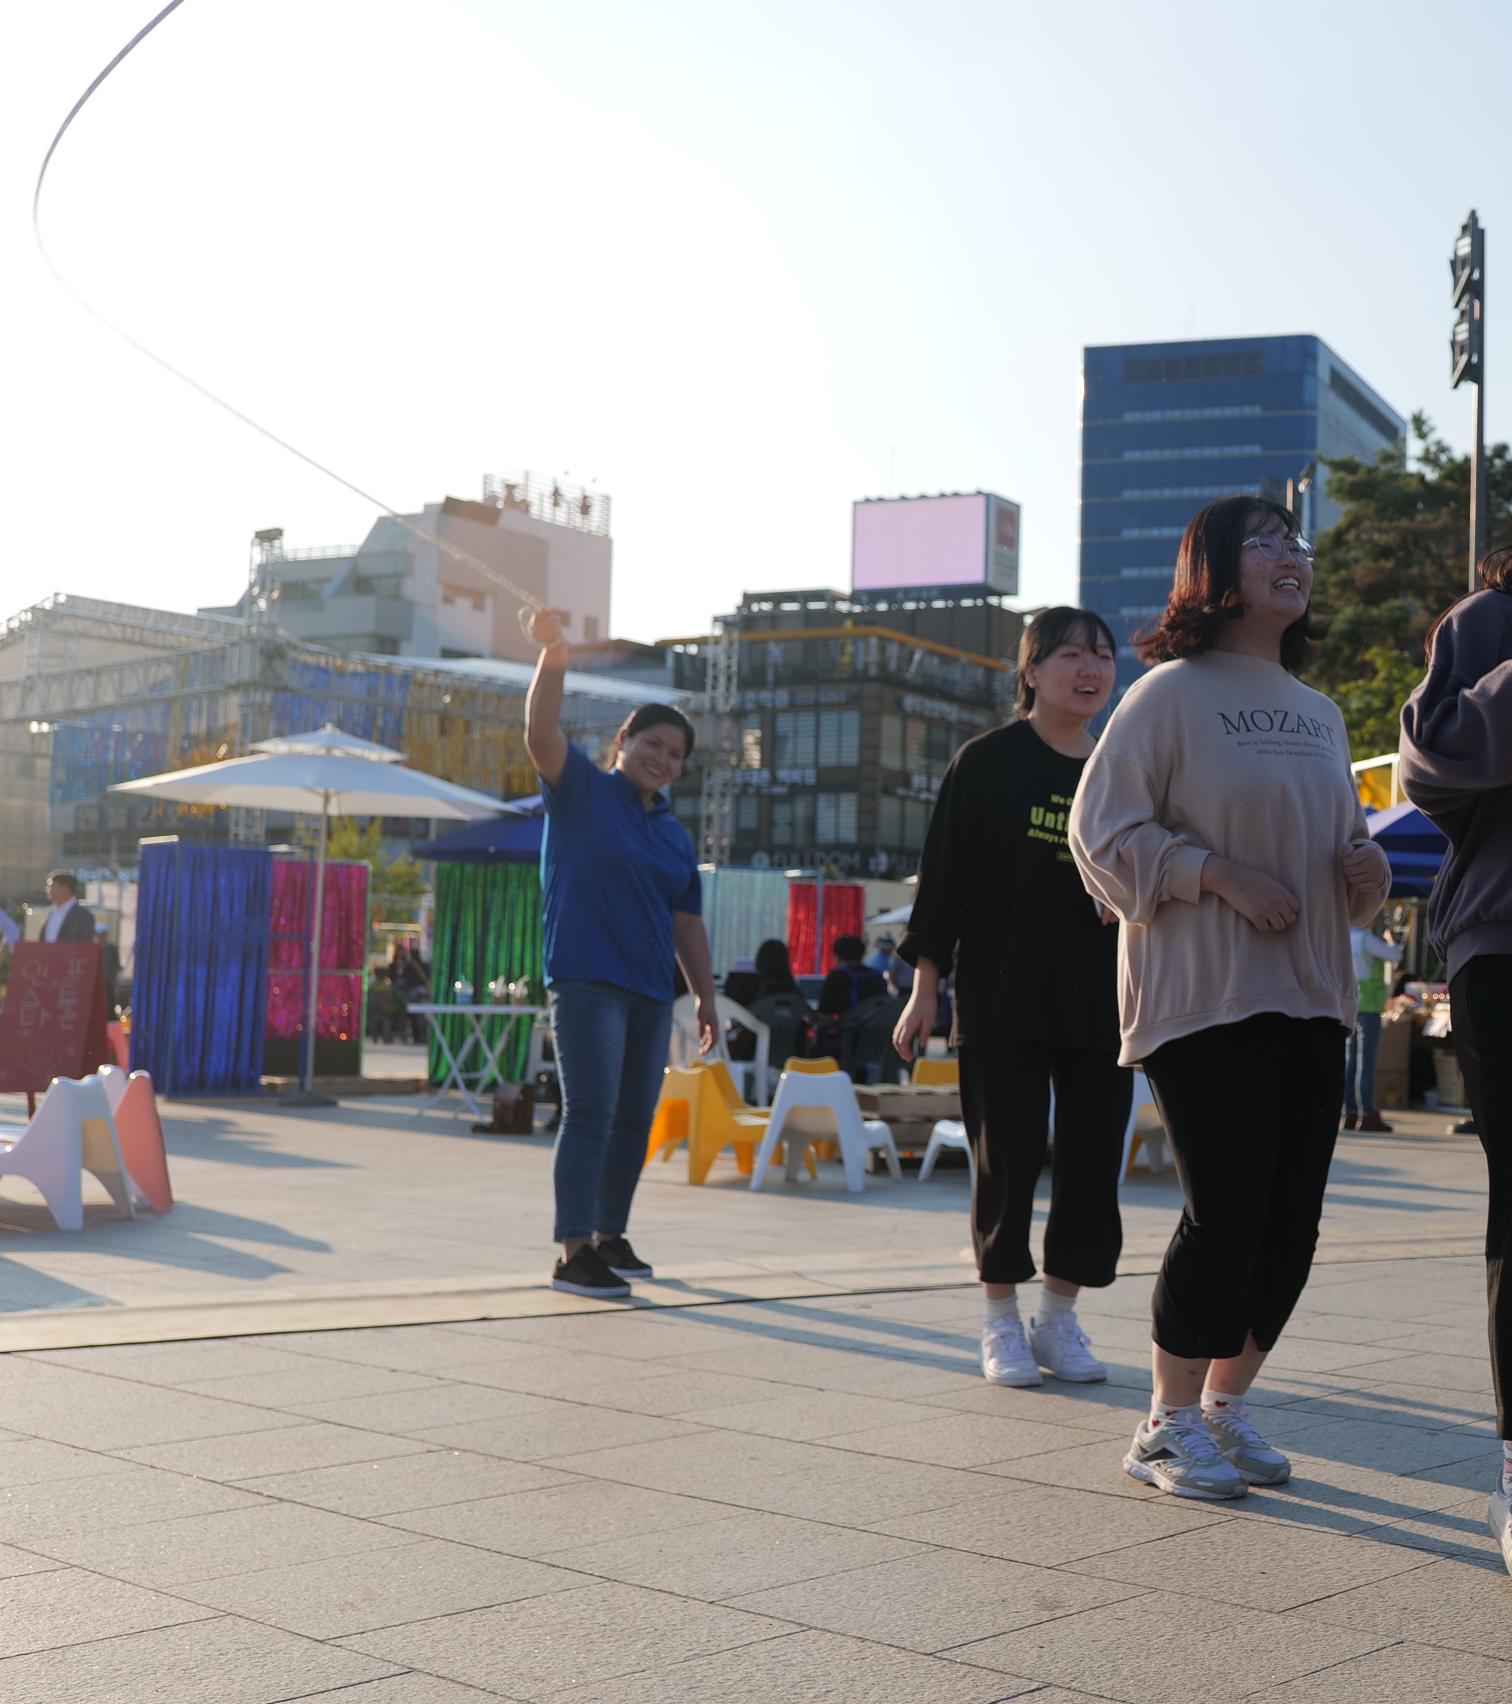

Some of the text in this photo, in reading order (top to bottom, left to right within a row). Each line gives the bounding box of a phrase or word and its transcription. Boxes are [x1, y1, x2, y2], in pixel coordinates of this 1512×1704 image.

[1217, 709, 1337, 747] MOZART
[1050, 794, 1066, 805] We
[1027, 827, 1060, 844] Always
